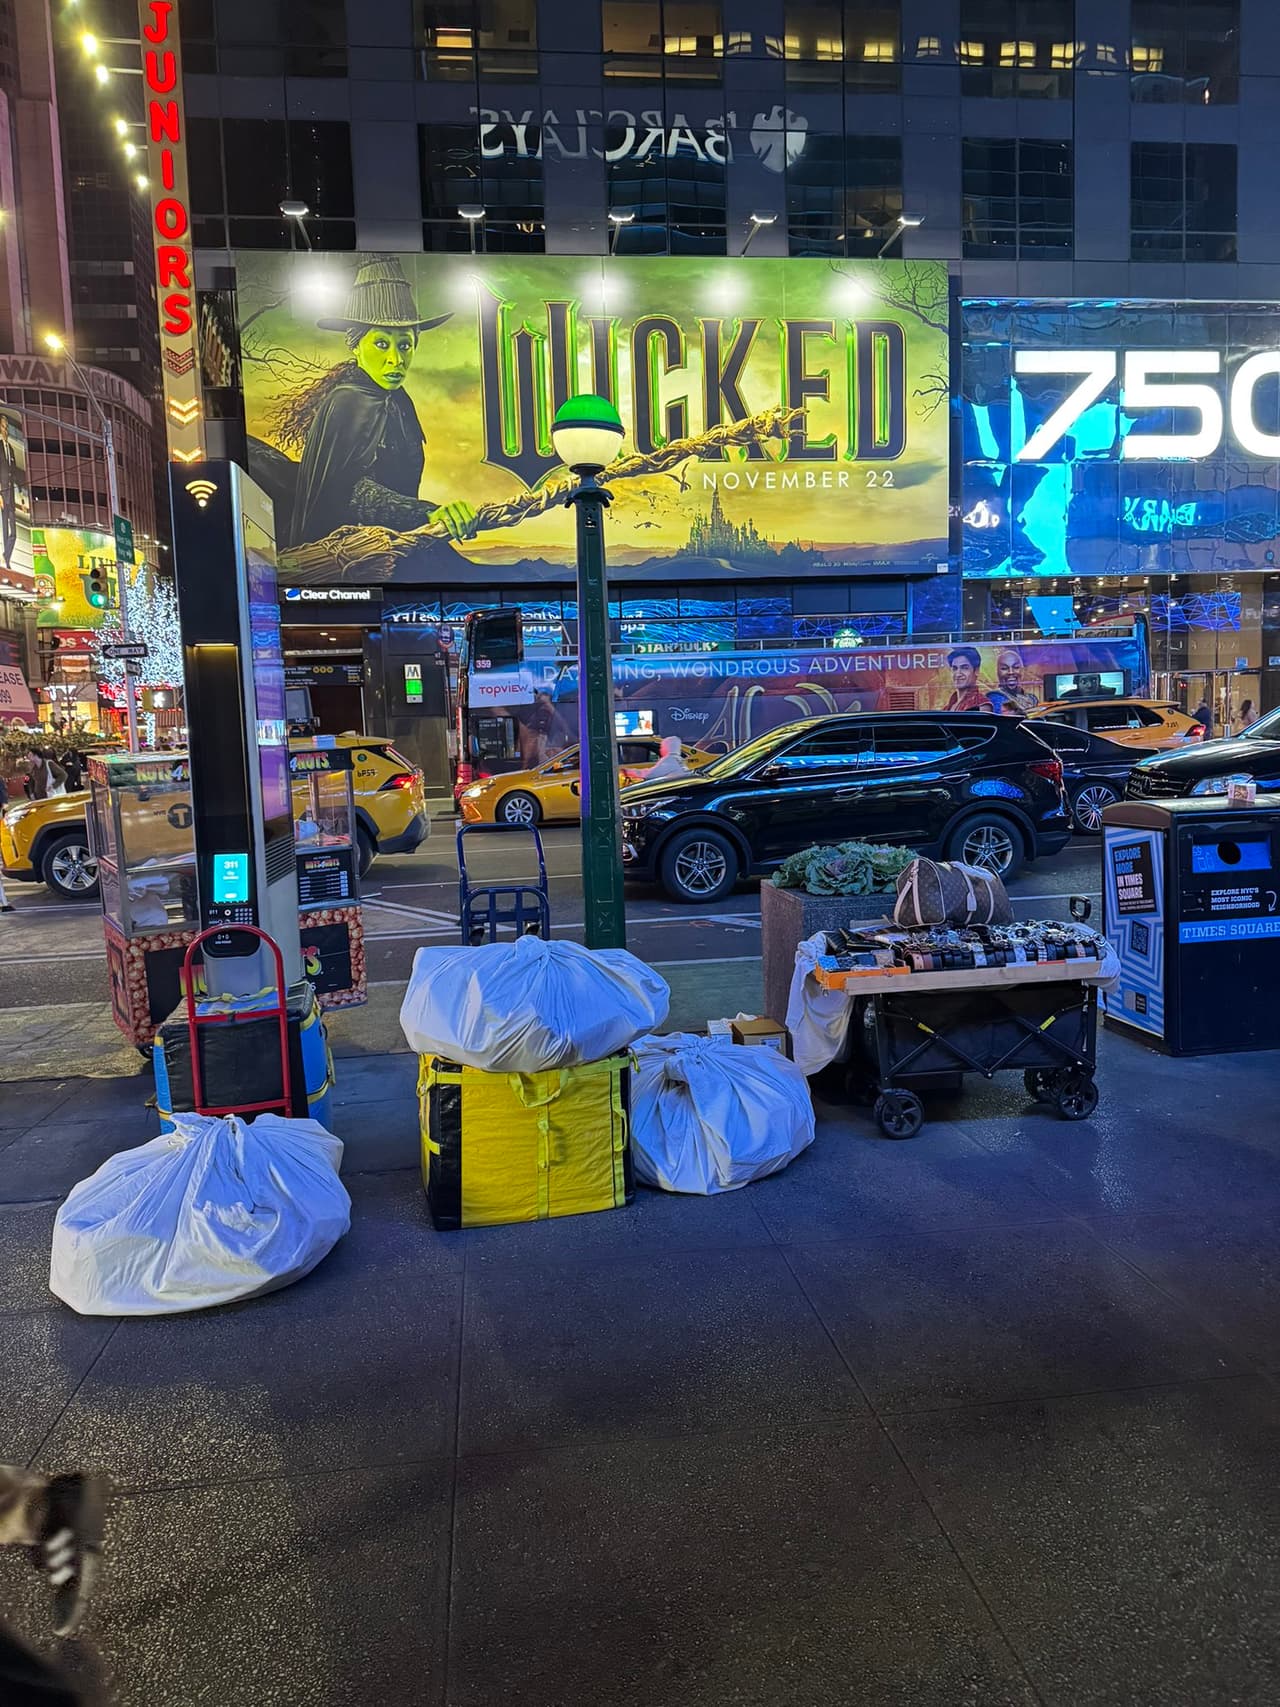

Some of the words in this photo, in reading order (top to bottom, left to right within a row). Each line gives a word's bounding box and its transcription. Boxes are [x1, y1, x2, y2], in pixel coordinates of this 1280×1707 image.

[144, 2, 192, 334] JUNIORS
[469, 275, 907, 493] WICKED
[702, 471, 849, 490] NOVEMBER
[866, 470, 895, 488] 22
[301, 589, 328, 600] Clear
[329, 589, 371, 600] Channel
[475, 659, 492, 669] 359
[544, 661, 662, 682] DAING,
[669, 657, 801, 677] WONDROUS
[808, 653, 946, 673] ADVENTURE!
[223, 860, 239, 869] 311
[1124, 873, 1143, 886] TIMES
[1118, 886, 1143, 900] SQUARE
[1211, 888, 1240, 896] EXPLORE
[1240, 887, 1260, 895] NYC'S
[1211, 896, 1230, 904] MOST
[1182, 926, 1226, 938] TIMES
[1230, 922, 1280, 936] SQUARE
